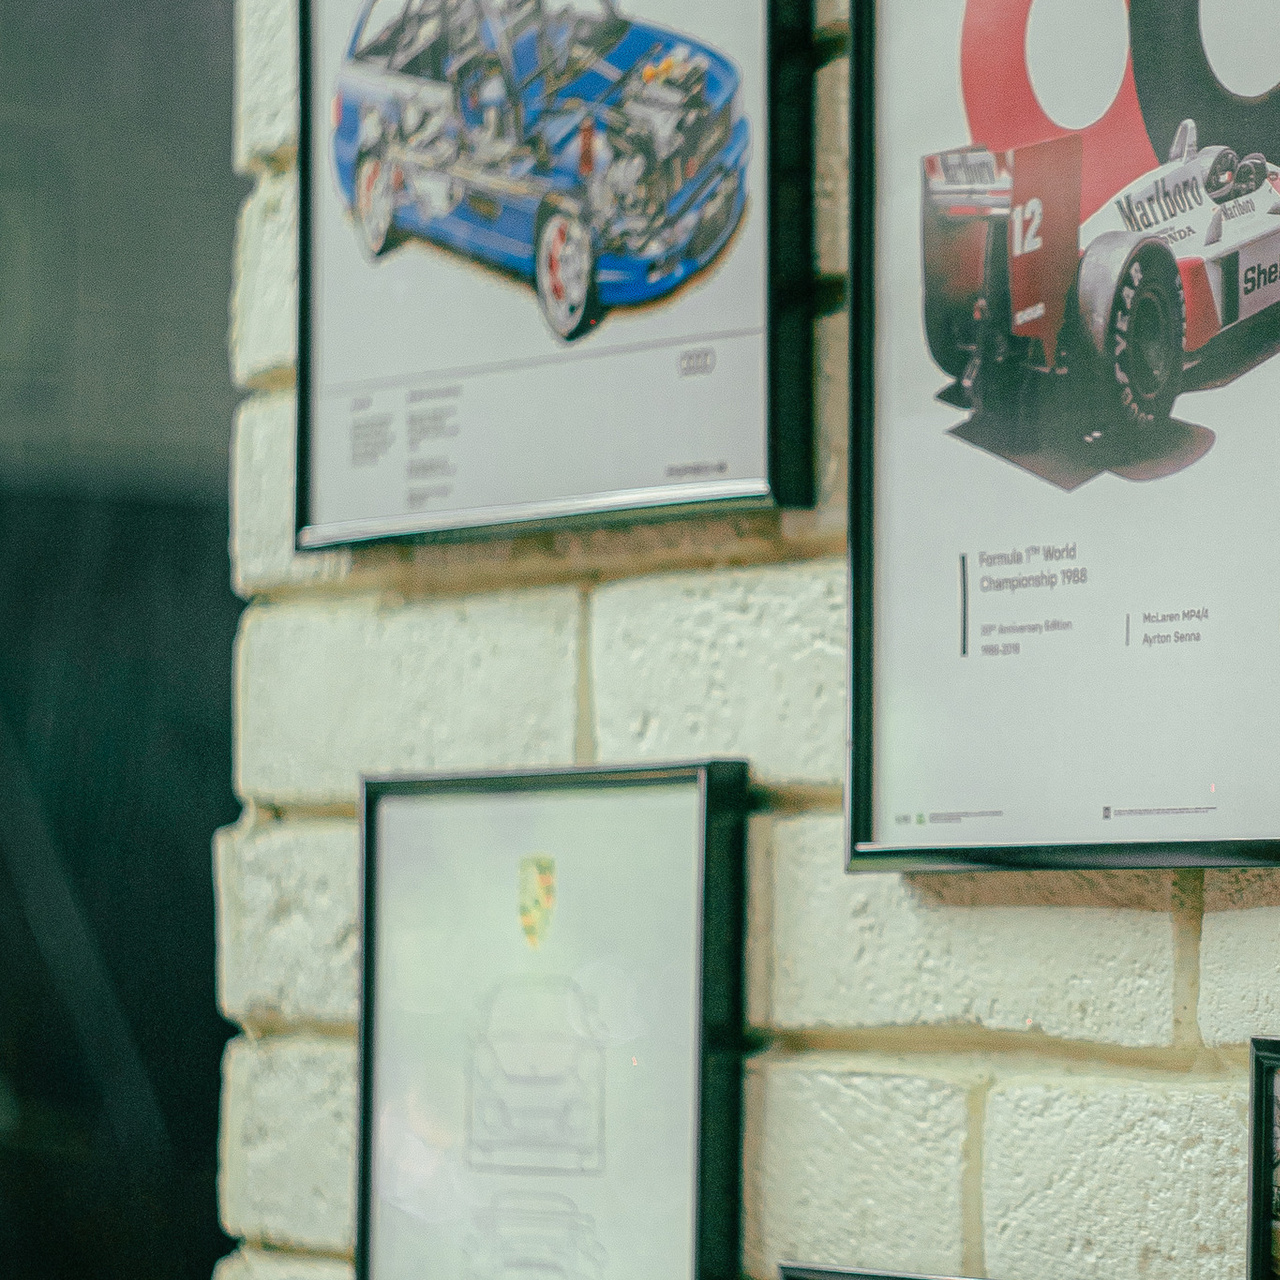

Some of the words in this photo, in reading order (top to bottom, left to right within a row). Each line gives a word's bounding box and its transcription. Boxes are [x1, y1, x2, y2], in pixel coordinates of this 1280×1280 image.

[1115, 176, 1205, 233] Marlboro
[1220, 197, 1257, 222] Marlboro
[1012, 197, 1044, 258] 12
[979, 548, 1023, 567] Formula
[1042, 541, 1077, 561] World
[980, 569, 1058, 594] Championship
[1060, 567, 1088, 586] 1988
[1143, 612, 1181, 624] McLaren
[1142, 632, 1171, 646] Ayrton
[1173, 630, 1202, 643] Senna
